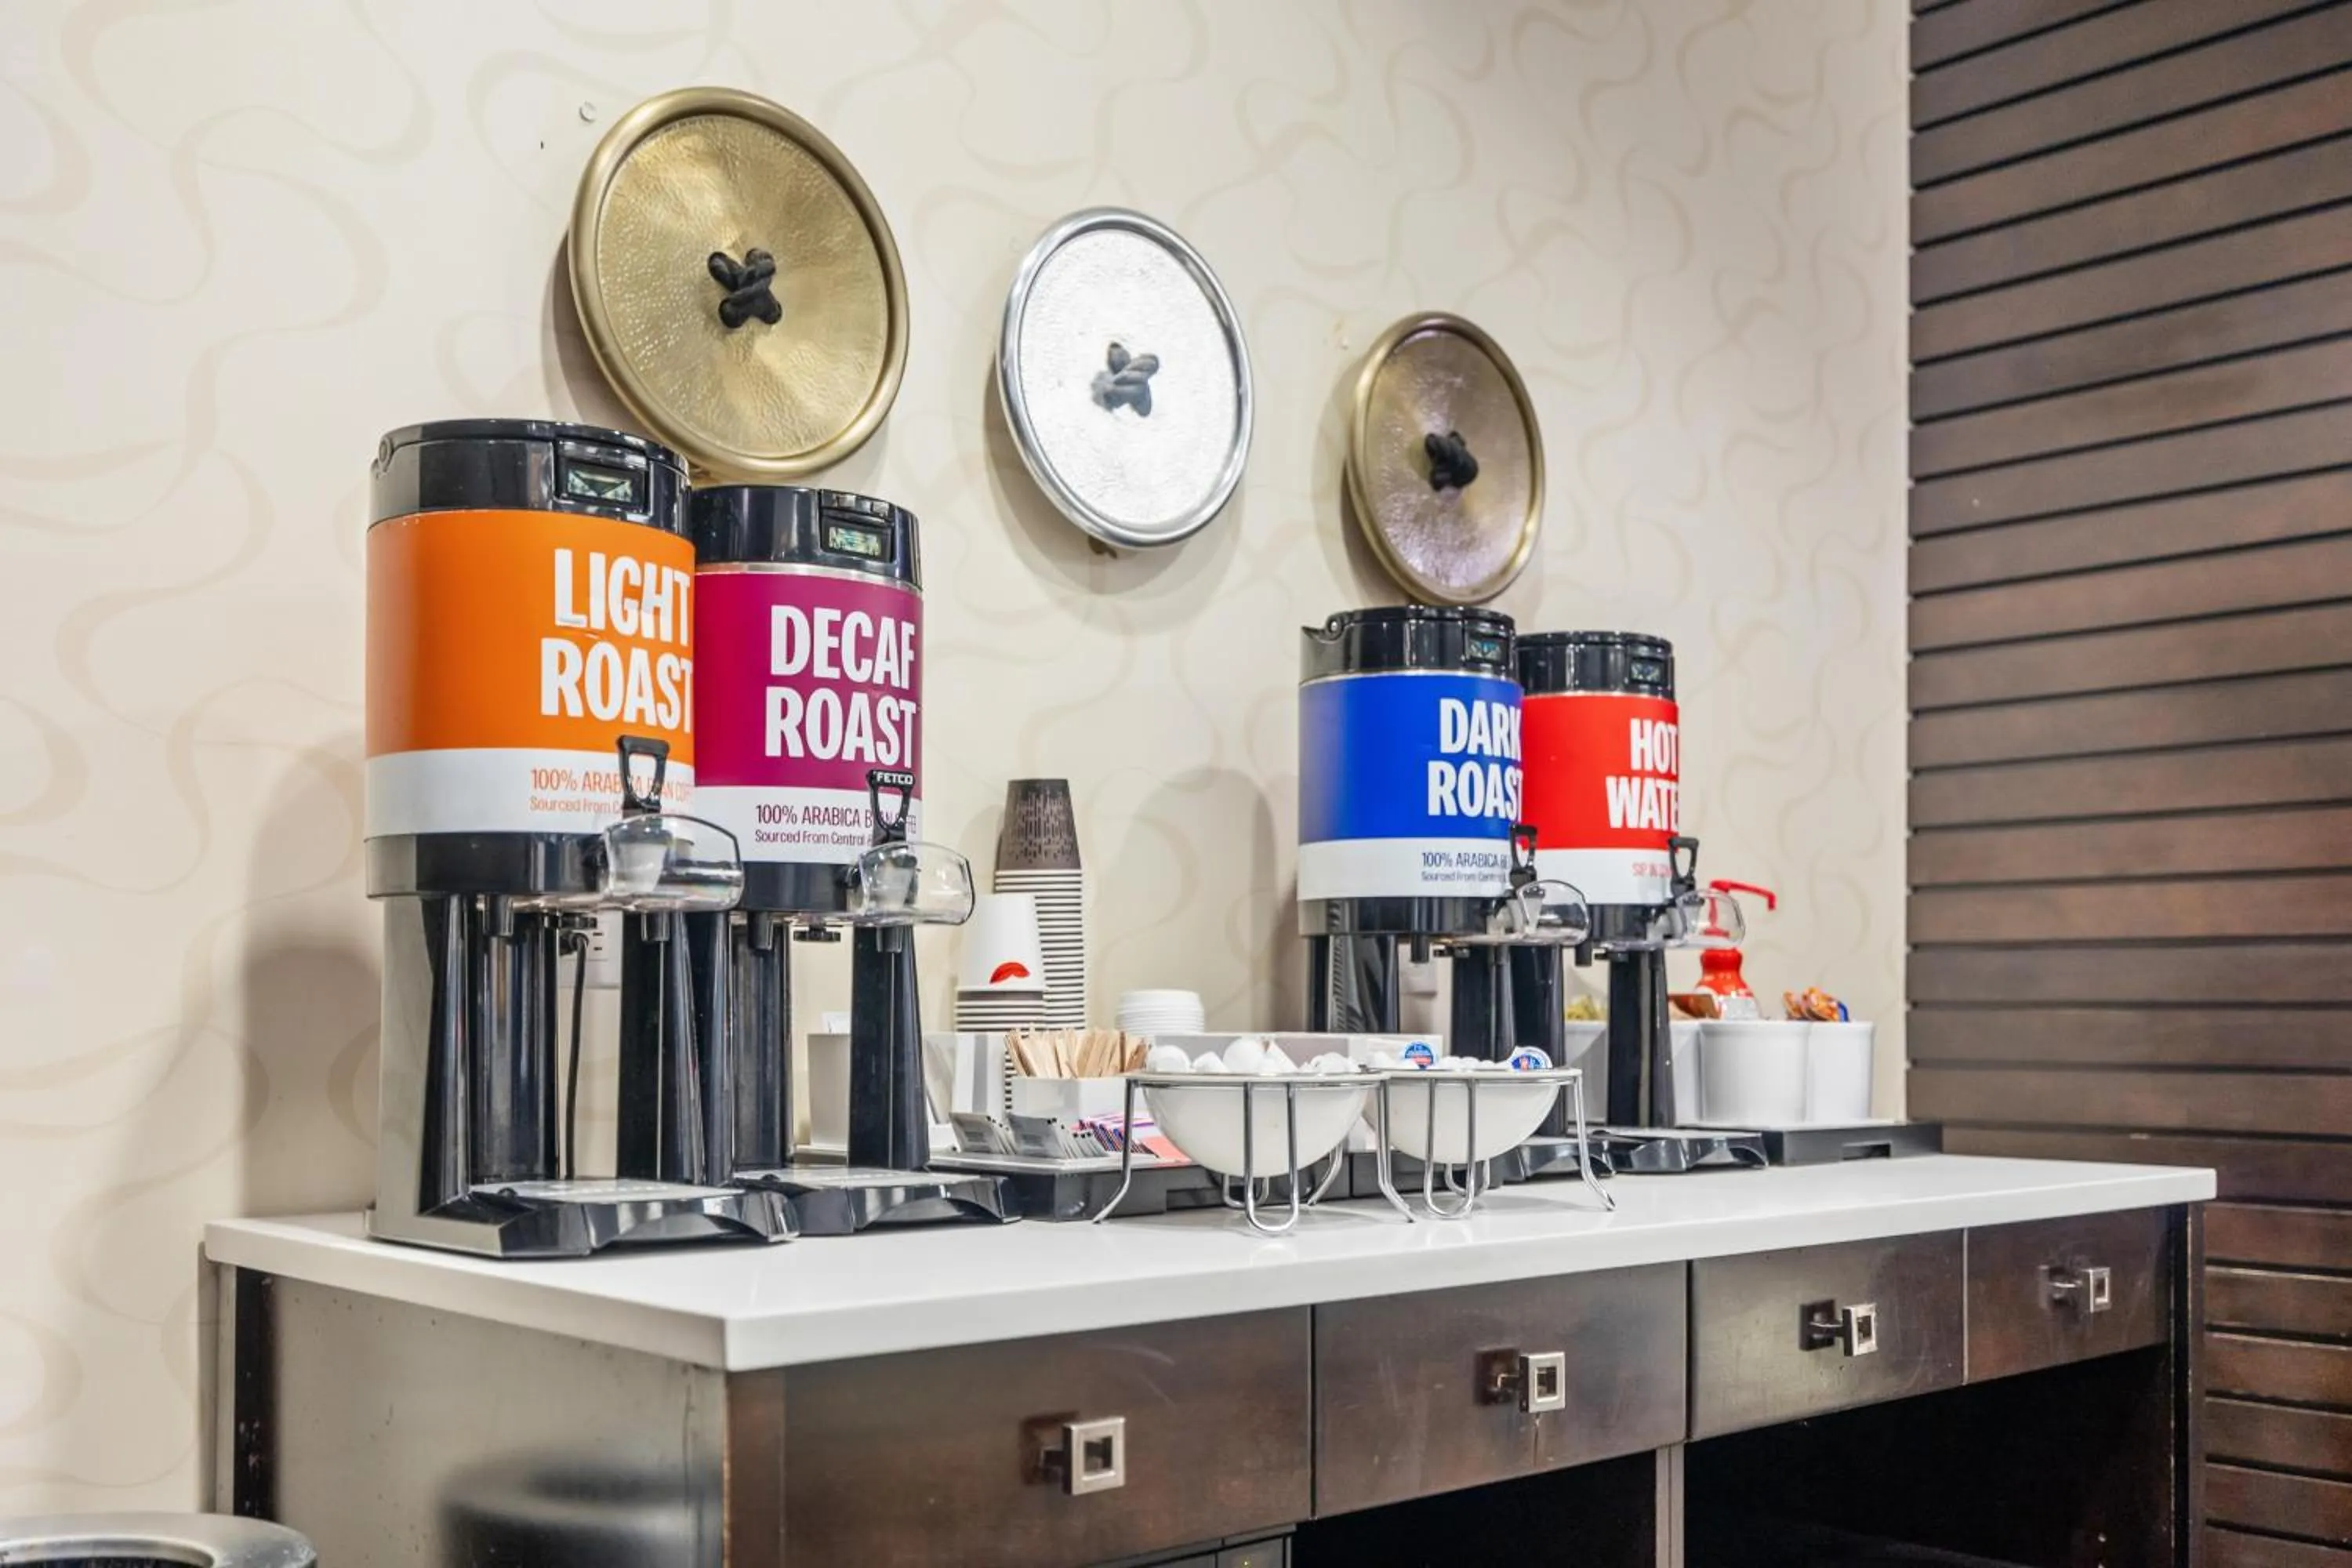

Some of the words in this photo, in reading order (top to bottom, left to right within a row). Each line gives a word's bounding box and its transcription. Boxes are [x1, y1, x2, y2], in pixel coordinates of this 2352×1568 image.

[554, 548, 691, 647] LIGHT
[771, 604, 915, 690] DECAF
[540, 637, 693, 734] ROAST
[764, 685, 916, 768] ROAST
[1439, 698, 1522, 763] DARK
[1630, 717, 1678, 776] HOT
[529, 796, 580, 812] Sourced
[583, 797, 610, 815] From
[531, 768, 578, 792] 100%
[582, 771, 643, 797] ARABA
[876, 771, 913, 785] FETCO
[1428, 760, 1524, 823] ROAST
[1606, 775, 1679, 834] WATE
[754, 829, 800, 844] Sourced
[802, 829, 829, 844] From
[830, 832, 864, 847] Central
[756, 804, 797, 824] 100%
[801, 805, 861, 827] ARABICA
[1421, 852, 1453, 867] 100%
[1455, 852, 1500, 869] ARABICA
